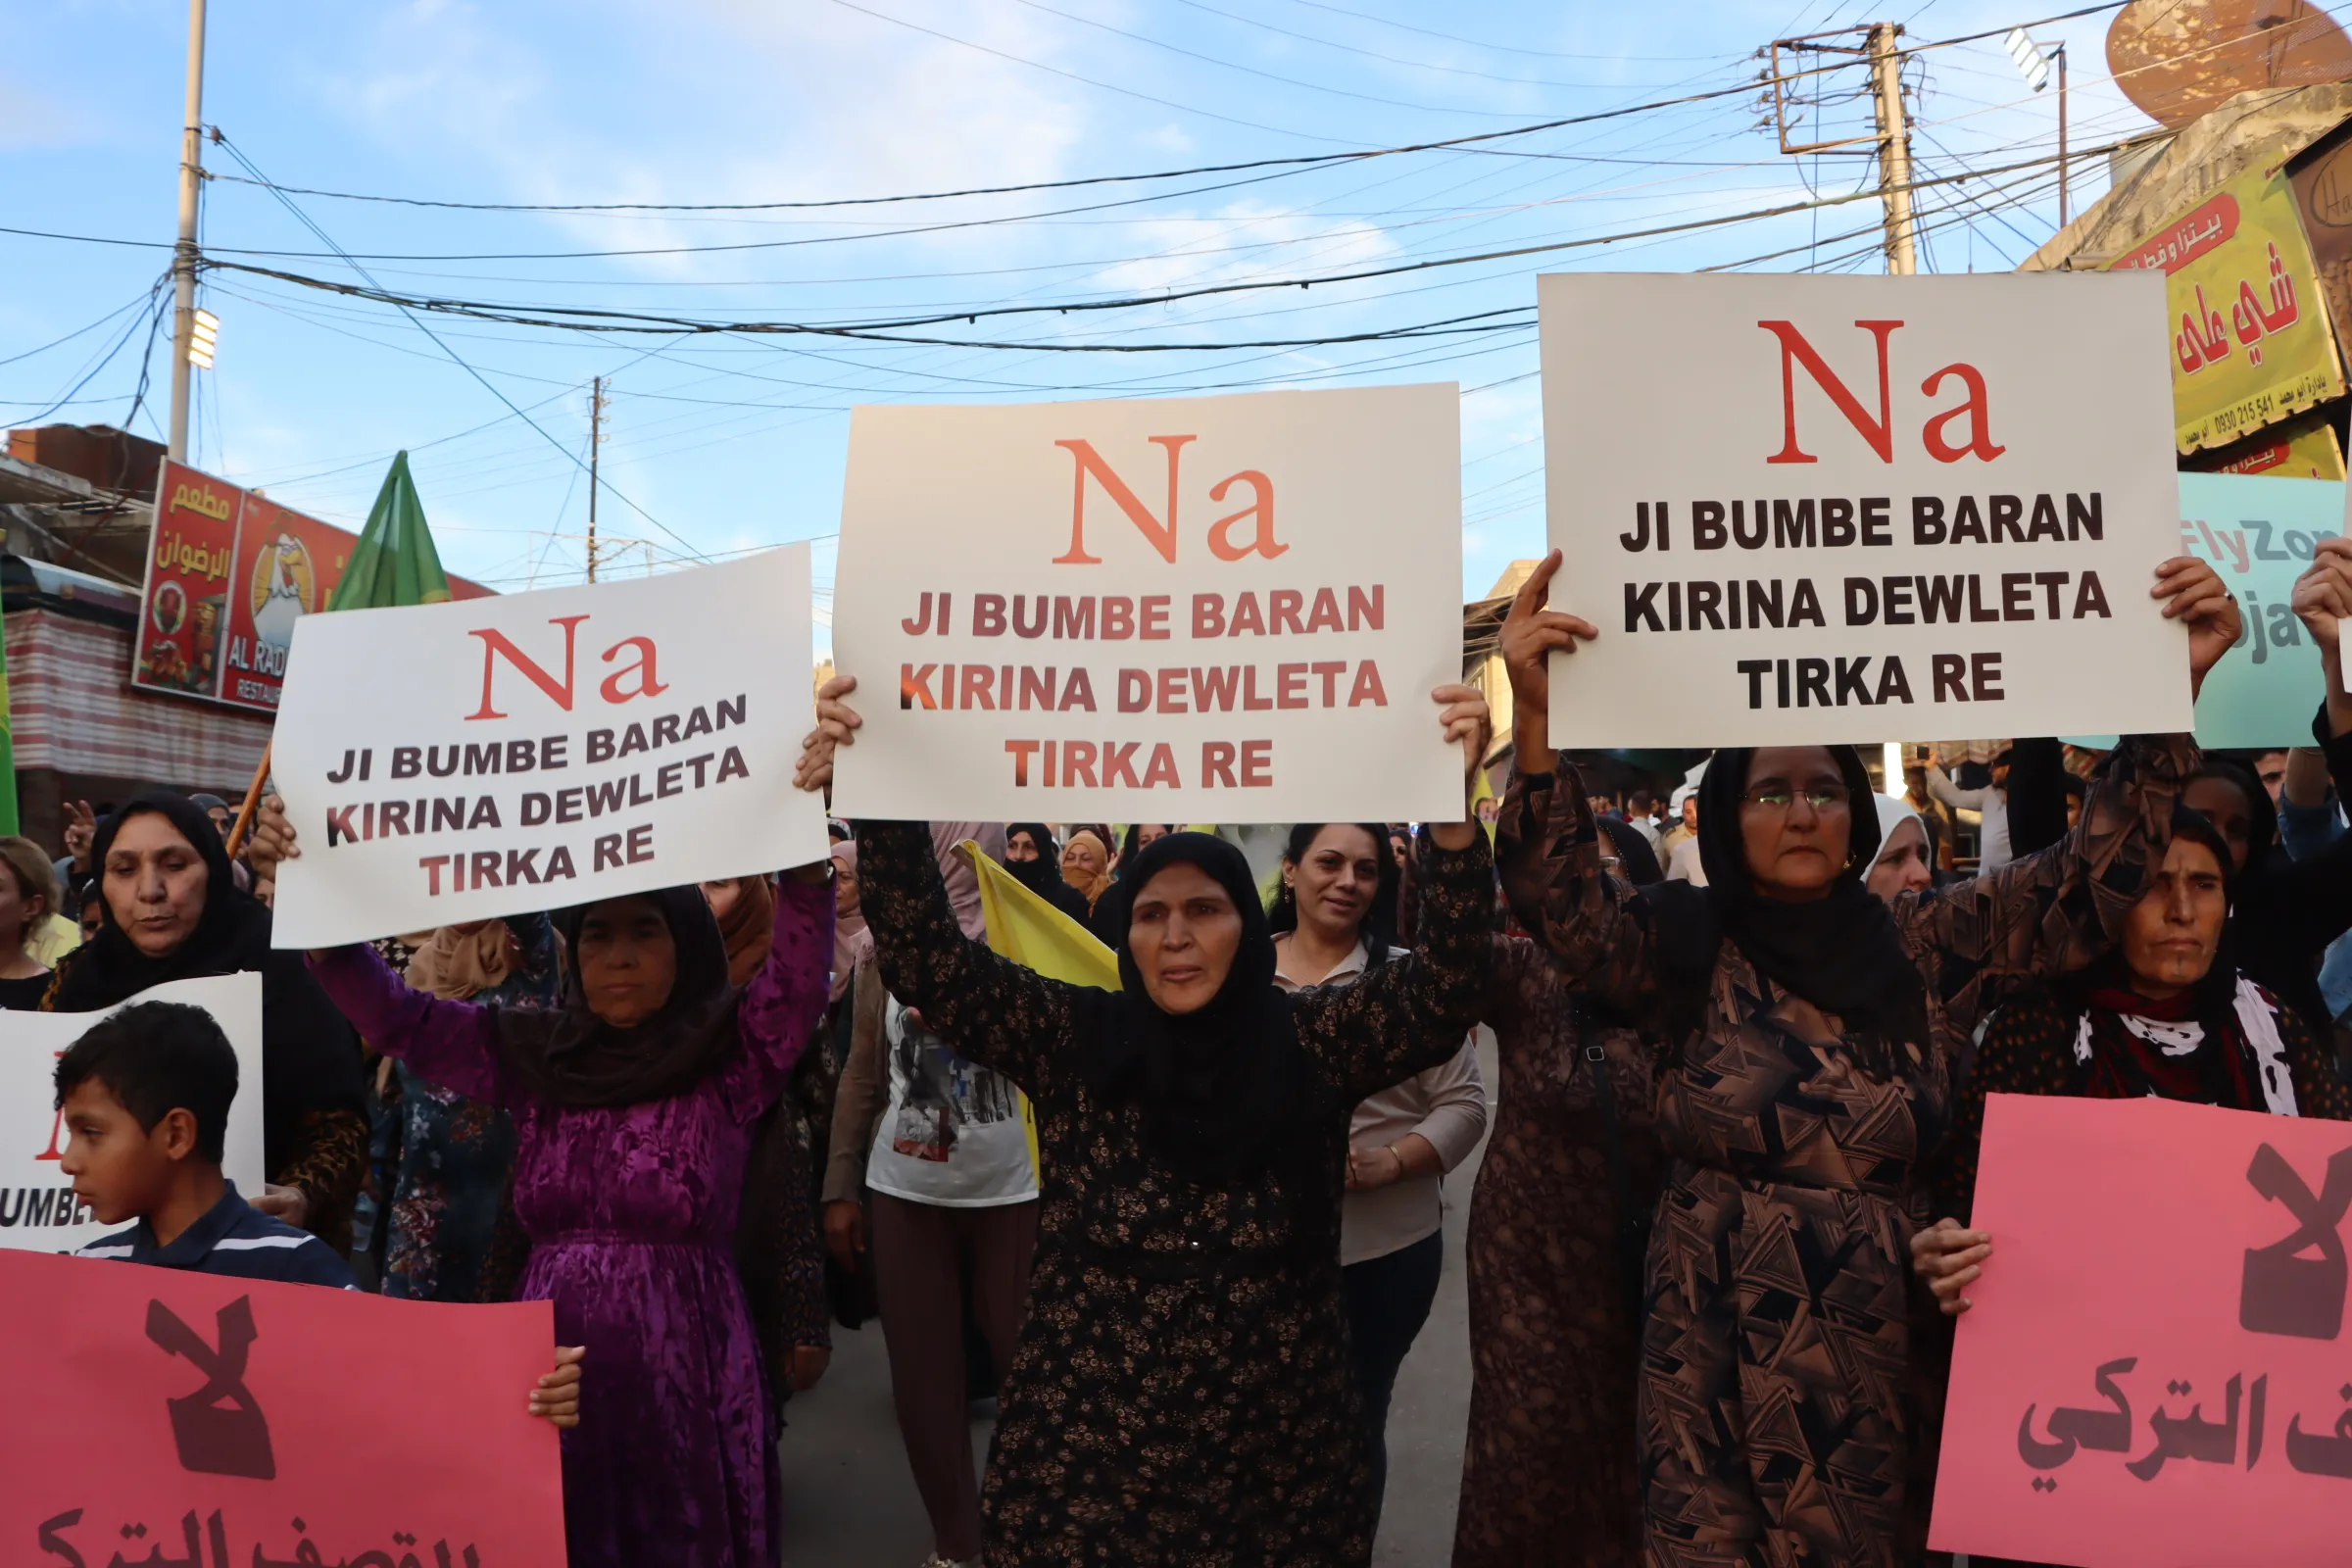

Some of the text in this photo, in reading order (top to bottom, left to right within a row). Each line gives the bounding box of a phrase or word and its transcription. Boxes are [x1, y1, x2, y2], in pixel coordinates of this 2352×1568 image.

[1758, 319, 2006, 464] Na
[2215, 410, 2237, 435] 0930
[2237, 401, 2256, 425] 215
[2256, 393, 2275, 417] 541
[170, 483, 230, 522] مطعم
[1053, 434, 1290, 564] Na
[1620, 493, 2103, 552] JI BUMBE BARAN
[156, 530, 230, 582] الرضوان
[902, 585, 1384, 639] JI BUMBE BARAN
[1625, 571, 2112, 632] KIRINA DEWLETA
[227, 635, 287, 677] AL RAD
[465, 614, 668, 720] Na
[901, 661, 1387, 712] KIRINA DEWLETA
[1738, 653, 2004, 709] TIRKA RE
[327, 695, 746, 783] JI BUMBE BARAN
[1005, 741, 1272, 788] TIRKA RE
[327, 746, 749, 847] KIRINA DEWLETA
[419, 824, 654, 896] TIRKA RE
[2239, 1143, 2352, 1341] لا
[146, 1295, 276, 1481] لا
[2018, 1357, 2267, 1493] التركي
